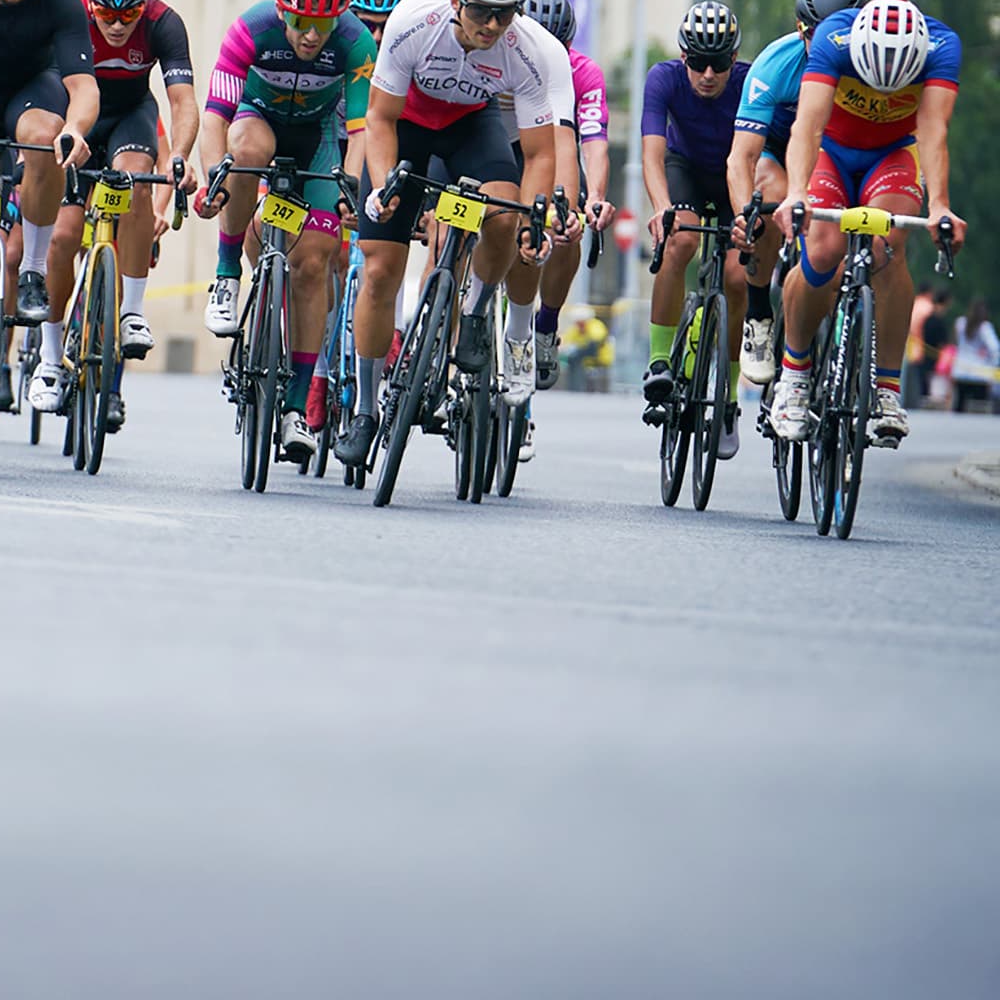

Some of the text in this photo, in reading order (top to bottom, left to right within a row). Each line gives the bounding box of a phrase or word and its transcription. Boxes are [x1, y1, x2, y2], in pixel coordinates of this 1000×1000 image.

[104, 192, 122, 206] 183
[271, 203, 295, 221] 247
[452, 202, 468, 218] 52
[862, 211, 869, 225] 2
